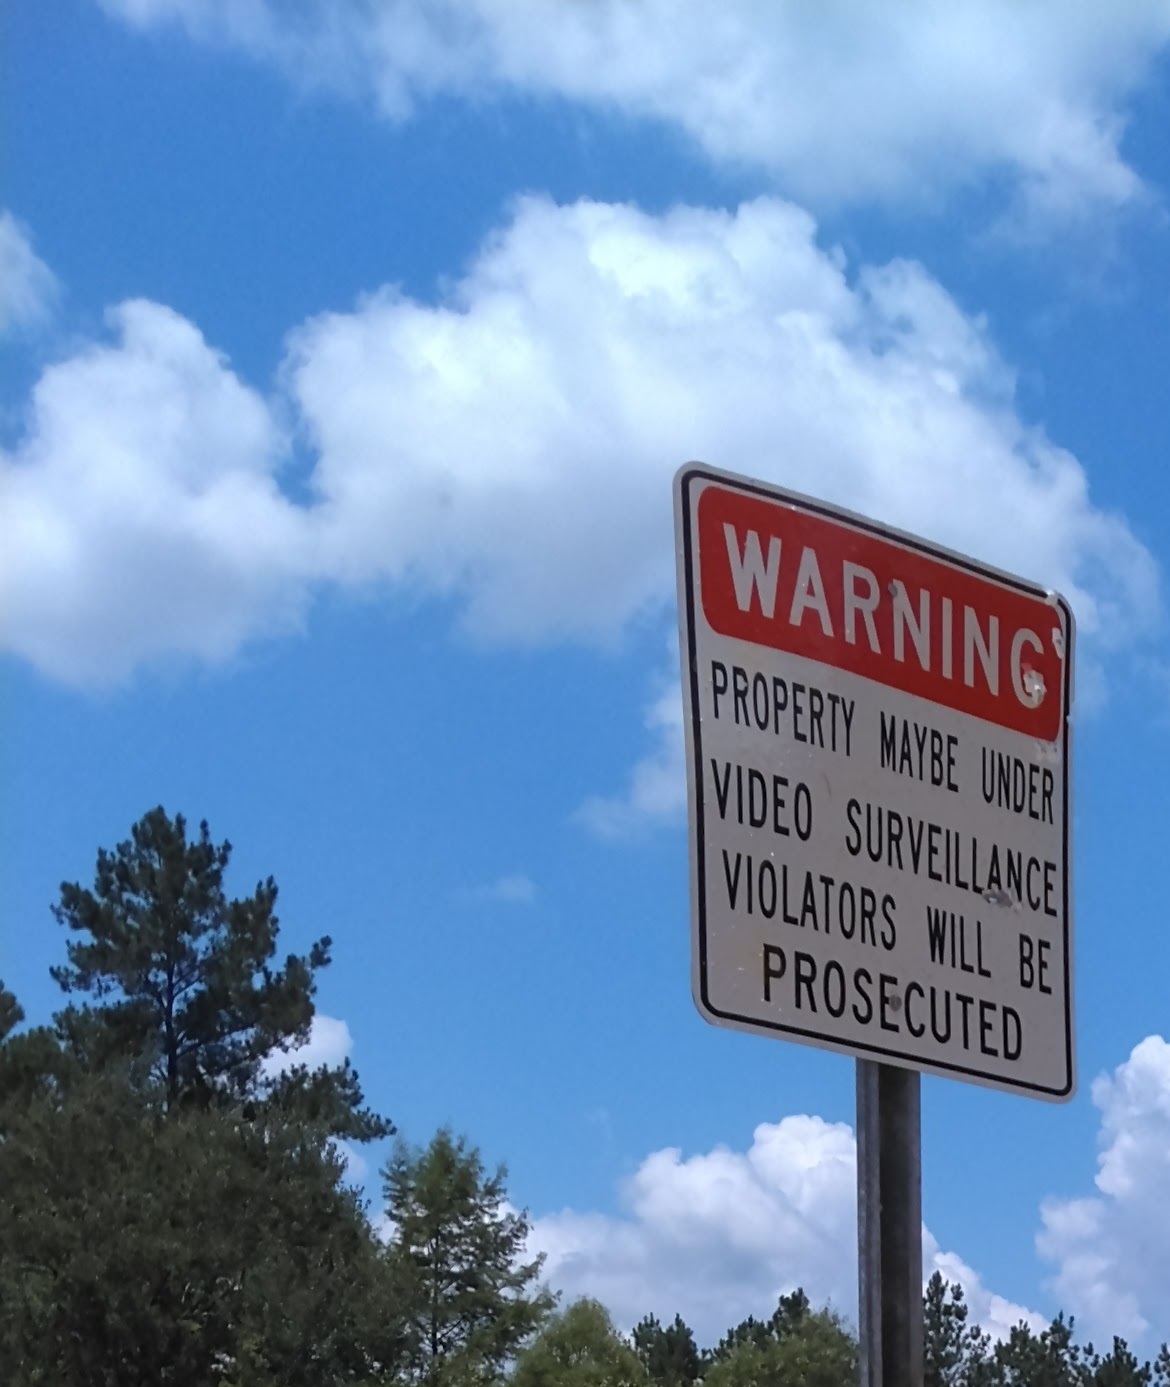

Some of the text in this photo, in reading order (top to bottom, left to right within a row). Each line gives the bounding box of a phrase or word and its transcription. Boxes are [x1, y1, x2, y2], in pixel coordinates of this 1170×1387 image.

[722, 521, 1047, 710] WARNING
[711, 659, 1054, 826] PROPERTY MAYBE UNDER
[710, 758, 1058, 918] VIDEO SURVEILLANCE
[721, 849, 1053, 996] VIOLATORS WILL BE
[762, 943, 1023, 1062] PROSECUTED
